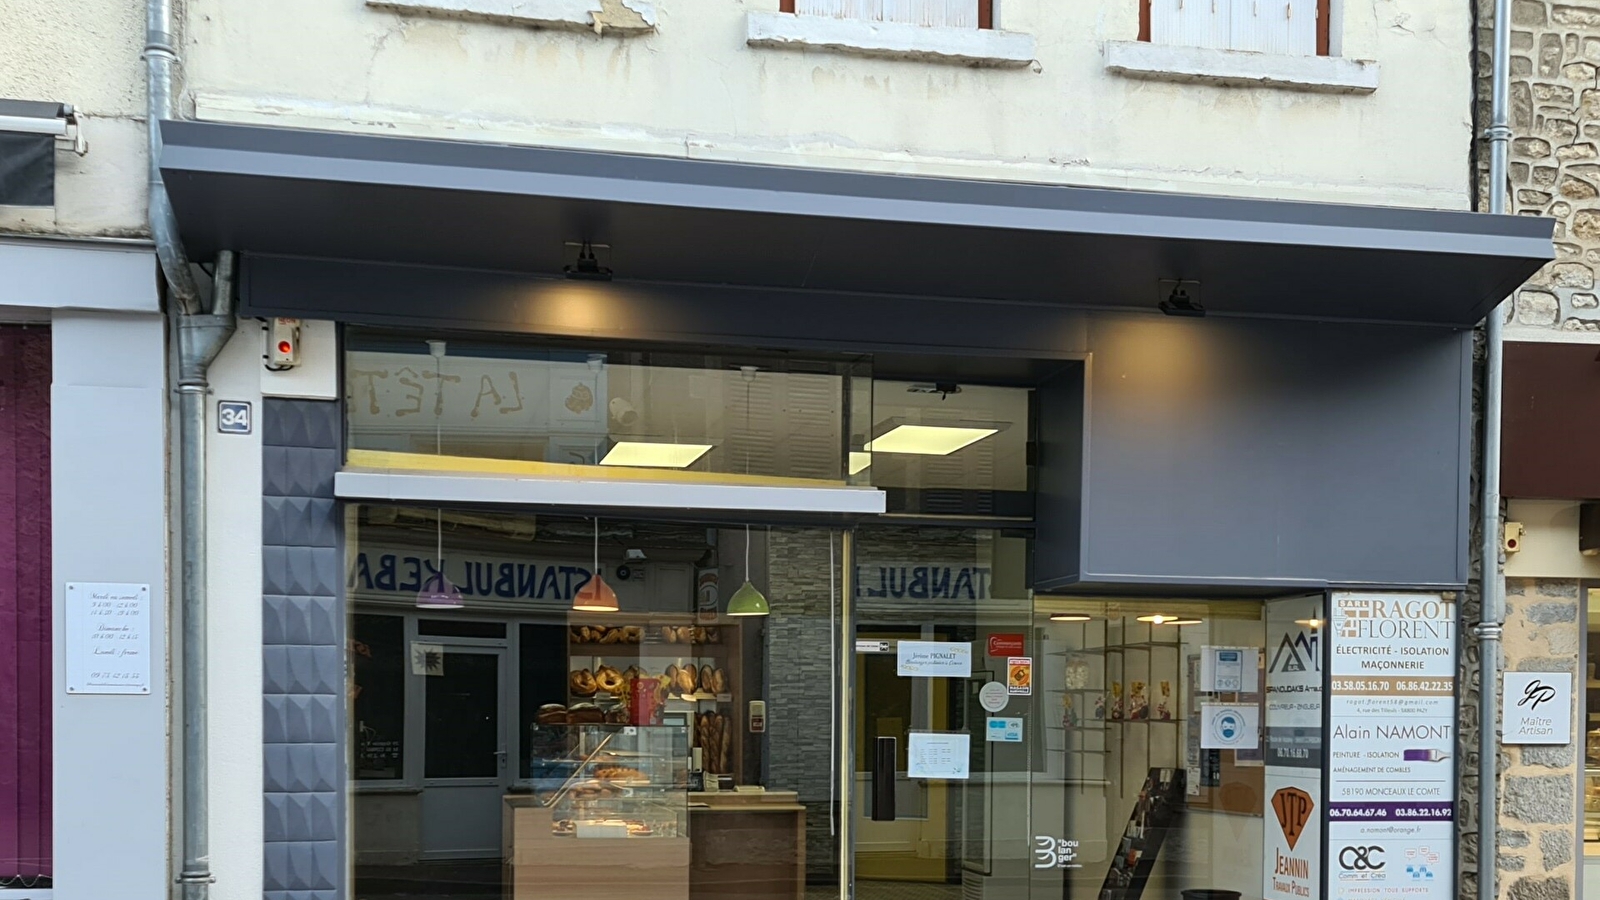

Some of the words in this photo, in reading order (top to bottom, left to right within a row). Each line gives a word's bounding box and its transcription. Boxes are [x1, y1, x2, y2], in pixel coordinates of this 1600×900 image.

[221, 408, 248, 426] 34
[1372, 600, 1453, 619] RAGOT
[1358, 619, 1456, 639] FLORENT
[1336, 644, 1391, 655] ÉLECTRICITÉ
[1400, 647, 1449, 656] ISOLATION
[1361, 660, 1425, 671] MAÇONNERIE
[1332, 681, 1389, 691] 03.58.05.16.70
[1396, 681, 1453, 691] 06.86.42.22.35
[1520, 717, 1552, 726] Maître
[1333, 724, 1370, 739] Alain
[1376, 725, 1451, 739] NAMONT
[1518, 727, 1553, 735] Artisan
[1341, 788, 1364, 796] 58190
[1365, 788, 1406, 796] MONCEAUX
[1407, 788, 1414, 796] LE
[1415, 788, 1440, 796] COMTE
[1279, 792, 1307, 836] JTP
[1329, 808, 1387, 817] 06.70.64.67.46
[1395, 808, 1452, 817] 03.86.22.16.92
[1274, 847, 1309, 879] JEANNIN
[1338, 845, 1386, 870] C&C
